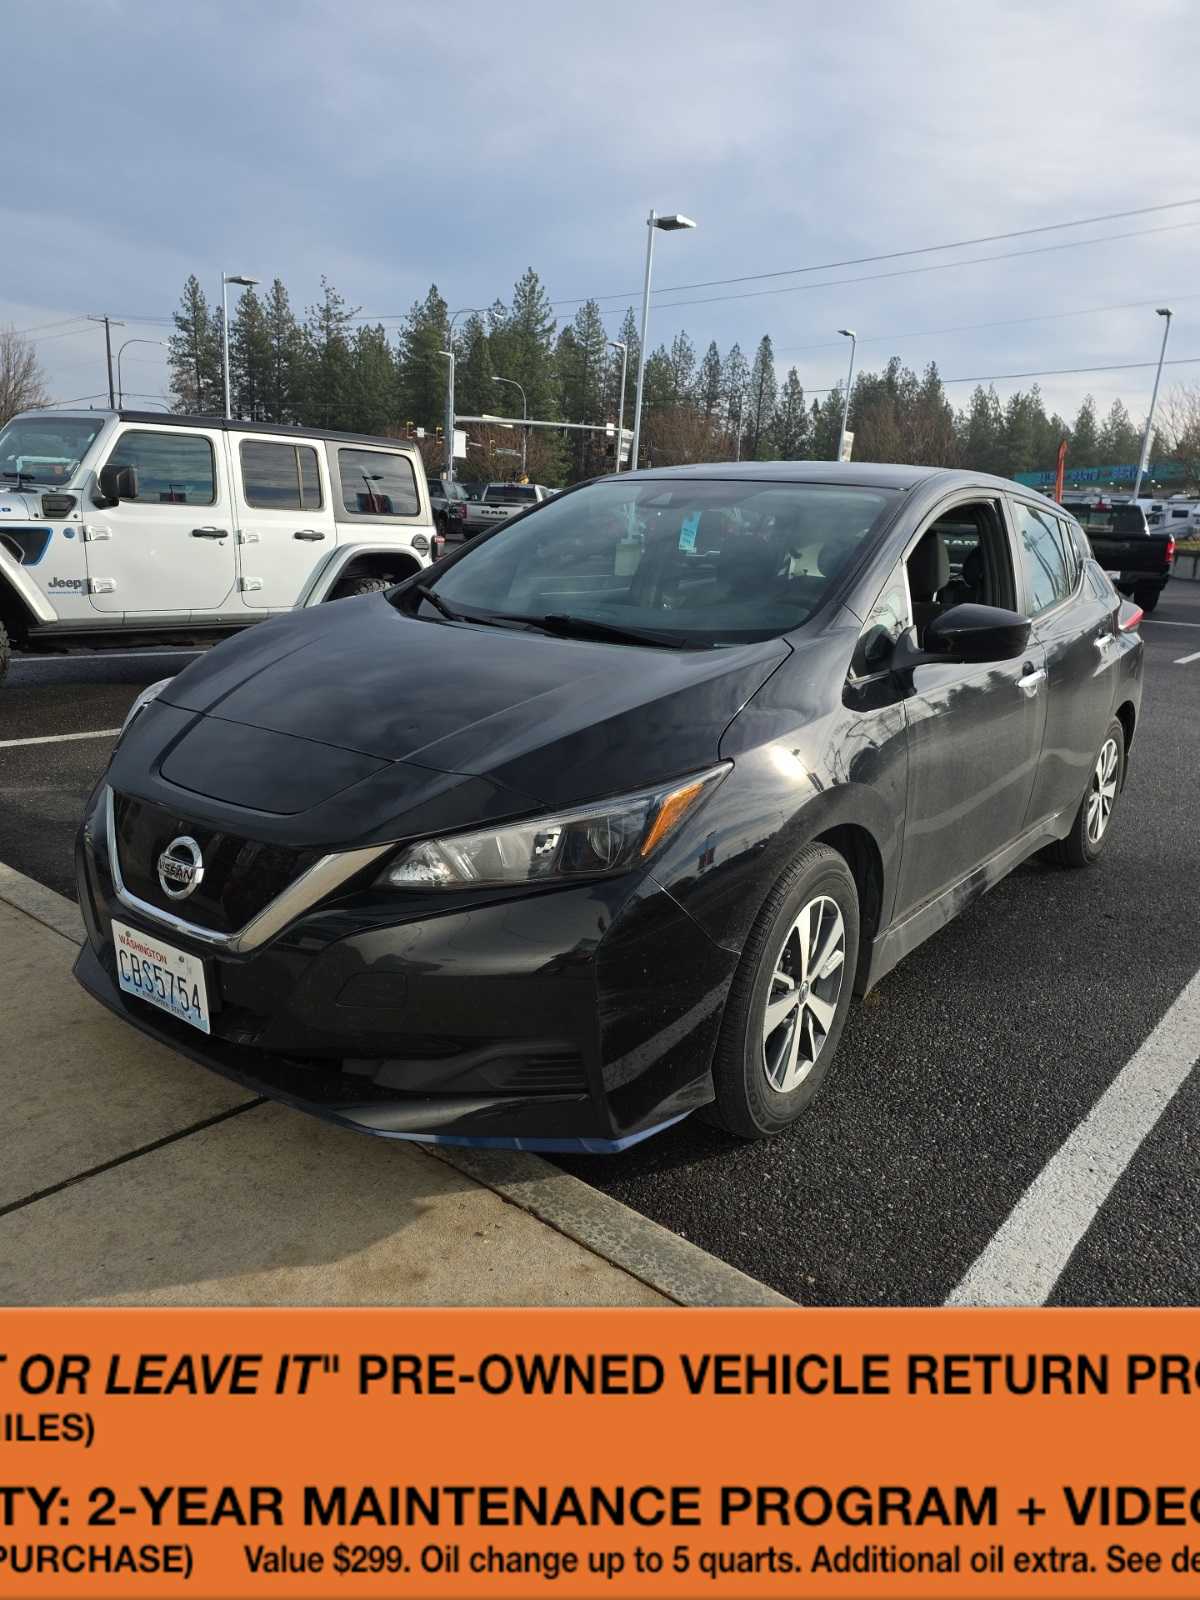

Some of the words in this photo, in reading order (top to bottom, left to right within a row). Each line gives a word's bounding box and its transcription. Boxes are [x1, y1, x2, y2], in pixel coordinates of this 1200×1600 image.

[48, 577, 82, 590] Jeep
[118, 934, 168, 965] WASHINGTON
[119, 949, 202, 1019] CBS5754
